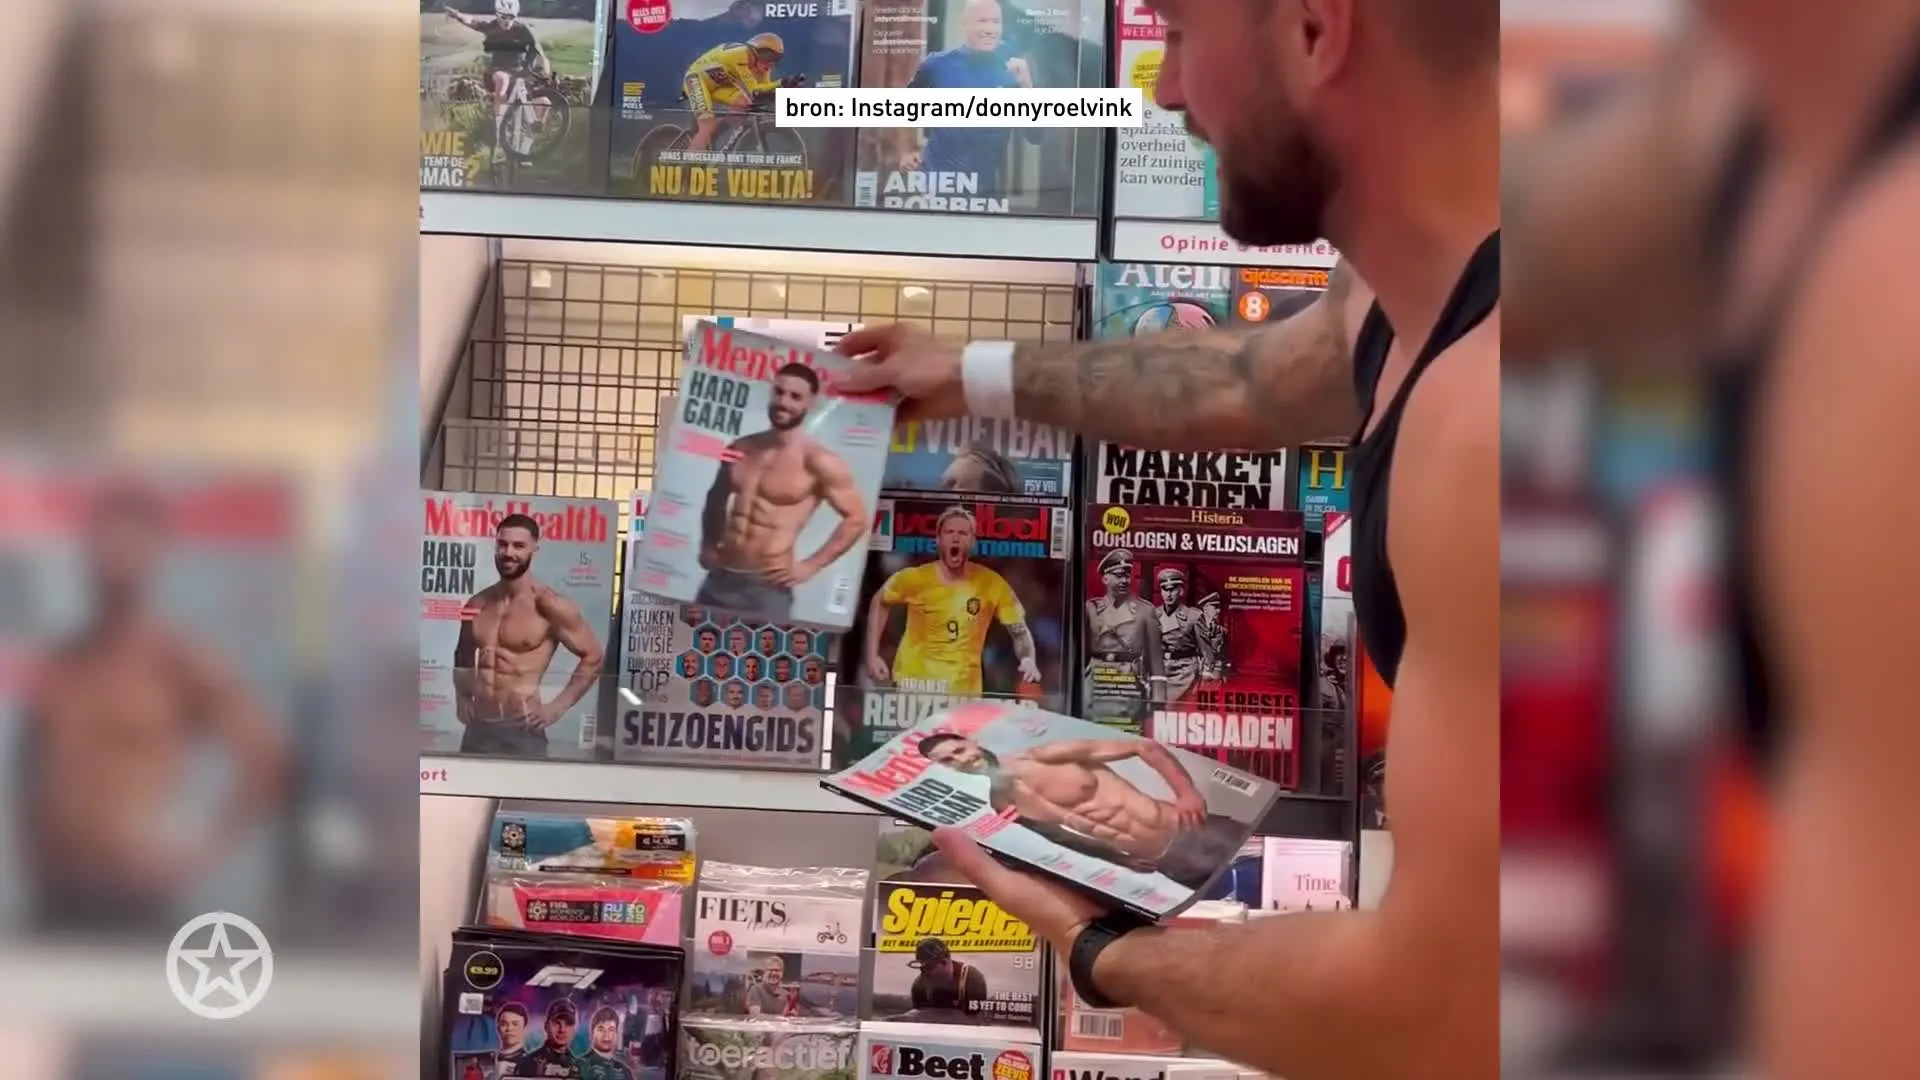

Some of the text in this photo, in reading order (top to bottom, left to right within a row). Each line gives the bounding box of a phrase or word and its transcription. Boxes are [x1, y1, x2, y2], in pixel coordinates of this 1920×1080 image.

[766, 4, 818, 17] REVUE
[420, 131, 465, 155] WIE
[1121, 139, 1186, 152] overheid
[776, 155, 803, 164] FRANCE
[1121, 155, 1150, 168] zelf
[420, 168, 463, 187] MAC
[651, 166, 814, 199] NU DE VUELTA!
[1120, 171, 1206, 186] kan worden
[1161, 235, 1229, 253] Opinie
[1246, 302, 1263, 322] 8
[689, 370, 750, 409] HARD
[683, 399, 744, 436] GAAN
[1104, 443, 1281, 484] MARKET
[1308, 450, 1345, 490] H
[1109, 477, 1272, 509] GARDEN
[1093, 529, 1299, 555] OORLOGEN & VELDSLAGEN
[422, 541, 477, 567] HARD
[421, 567, 475, 594] GAAN
[630, 608, 674, 626] KEUKEN
[947, 620, 958, 641] 9
[628, 636, 673, 654] DIVISIE
[627, 669, 670, 692] TOP
[622, 710, 815, 753] SEIZOENGIDS
[1153, 710, 1294, 751] MISDADEN
[888, 777, 955, 813] HARD
[920, 789, 988, 826] GAAN
[1292, 872, 1337, 891] Time
[701, 896, 787, 924] FIETS
[1013, 955, 1033, 969] 98
[968, 1000, 1033, 1013] IS YET TO COME
[995, 991, 1033, 1002] THE BEST
[898, 1047, 985, 1080] Beet
